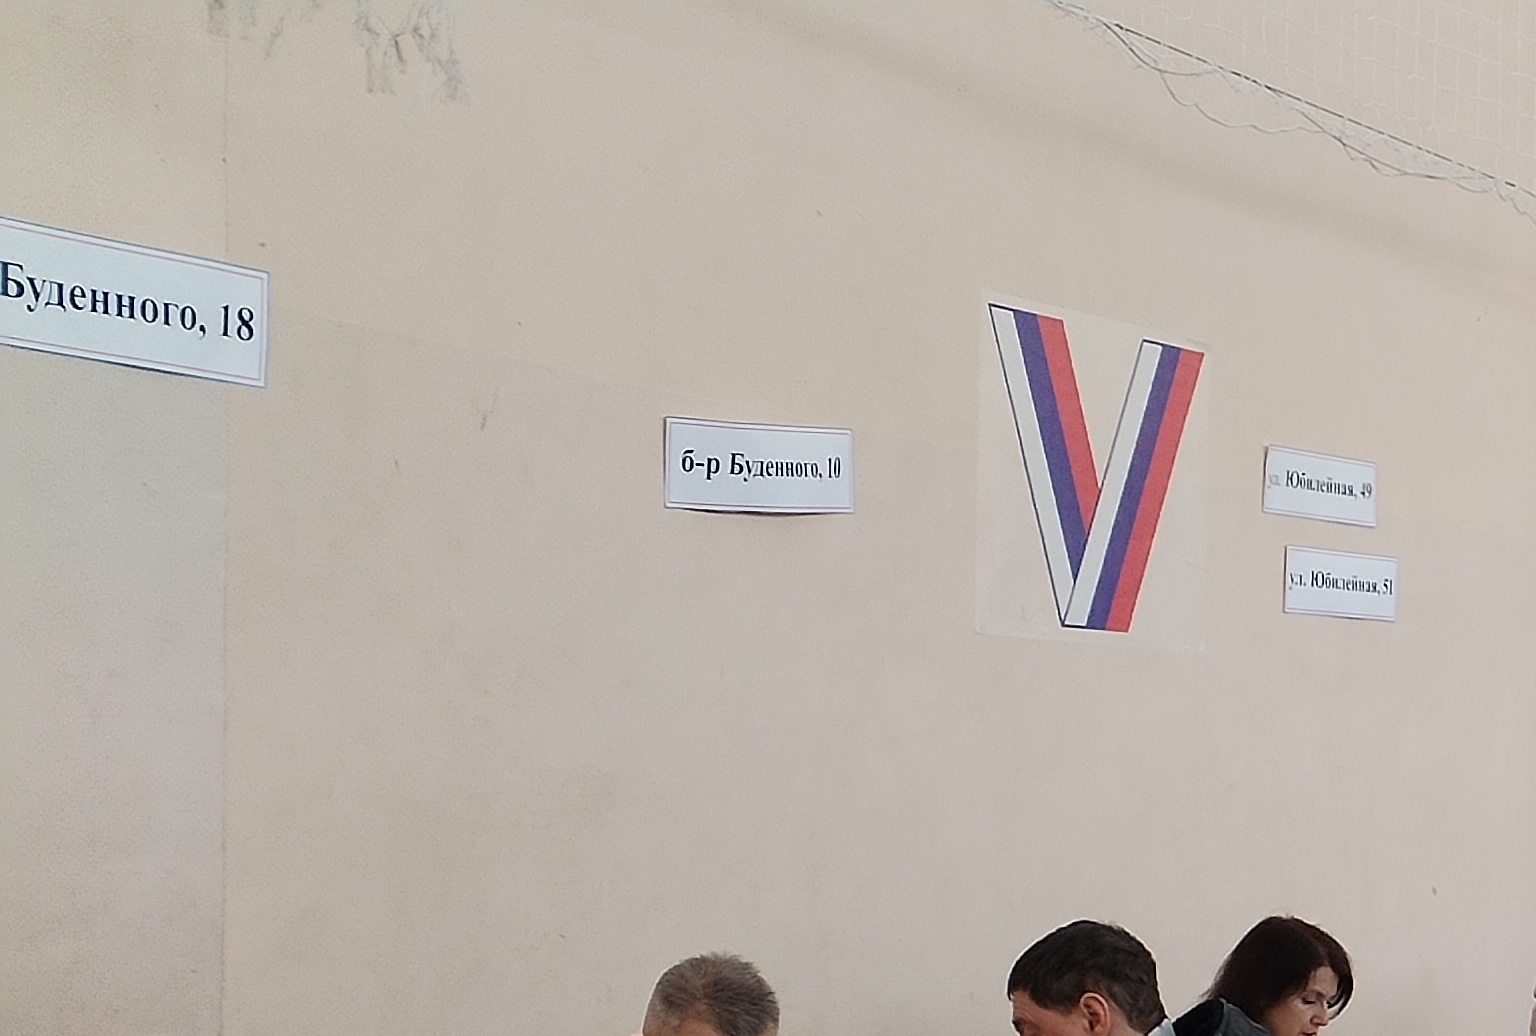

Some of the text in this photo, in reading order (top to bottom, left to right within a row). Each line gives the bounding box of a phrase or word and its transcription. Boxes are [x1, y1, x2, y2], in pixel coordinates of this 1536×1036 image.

[0, 260, 254, 341] Буденного, 18
[682, 449, 841, 482] б-р Буденного, 10
[988, 302, 1205, 633] V
[1360, 481, 1373, 499] 49
[1311, 569, 1381, 597] Юбилейная,
[1383, 578, 1393, 596] 51
